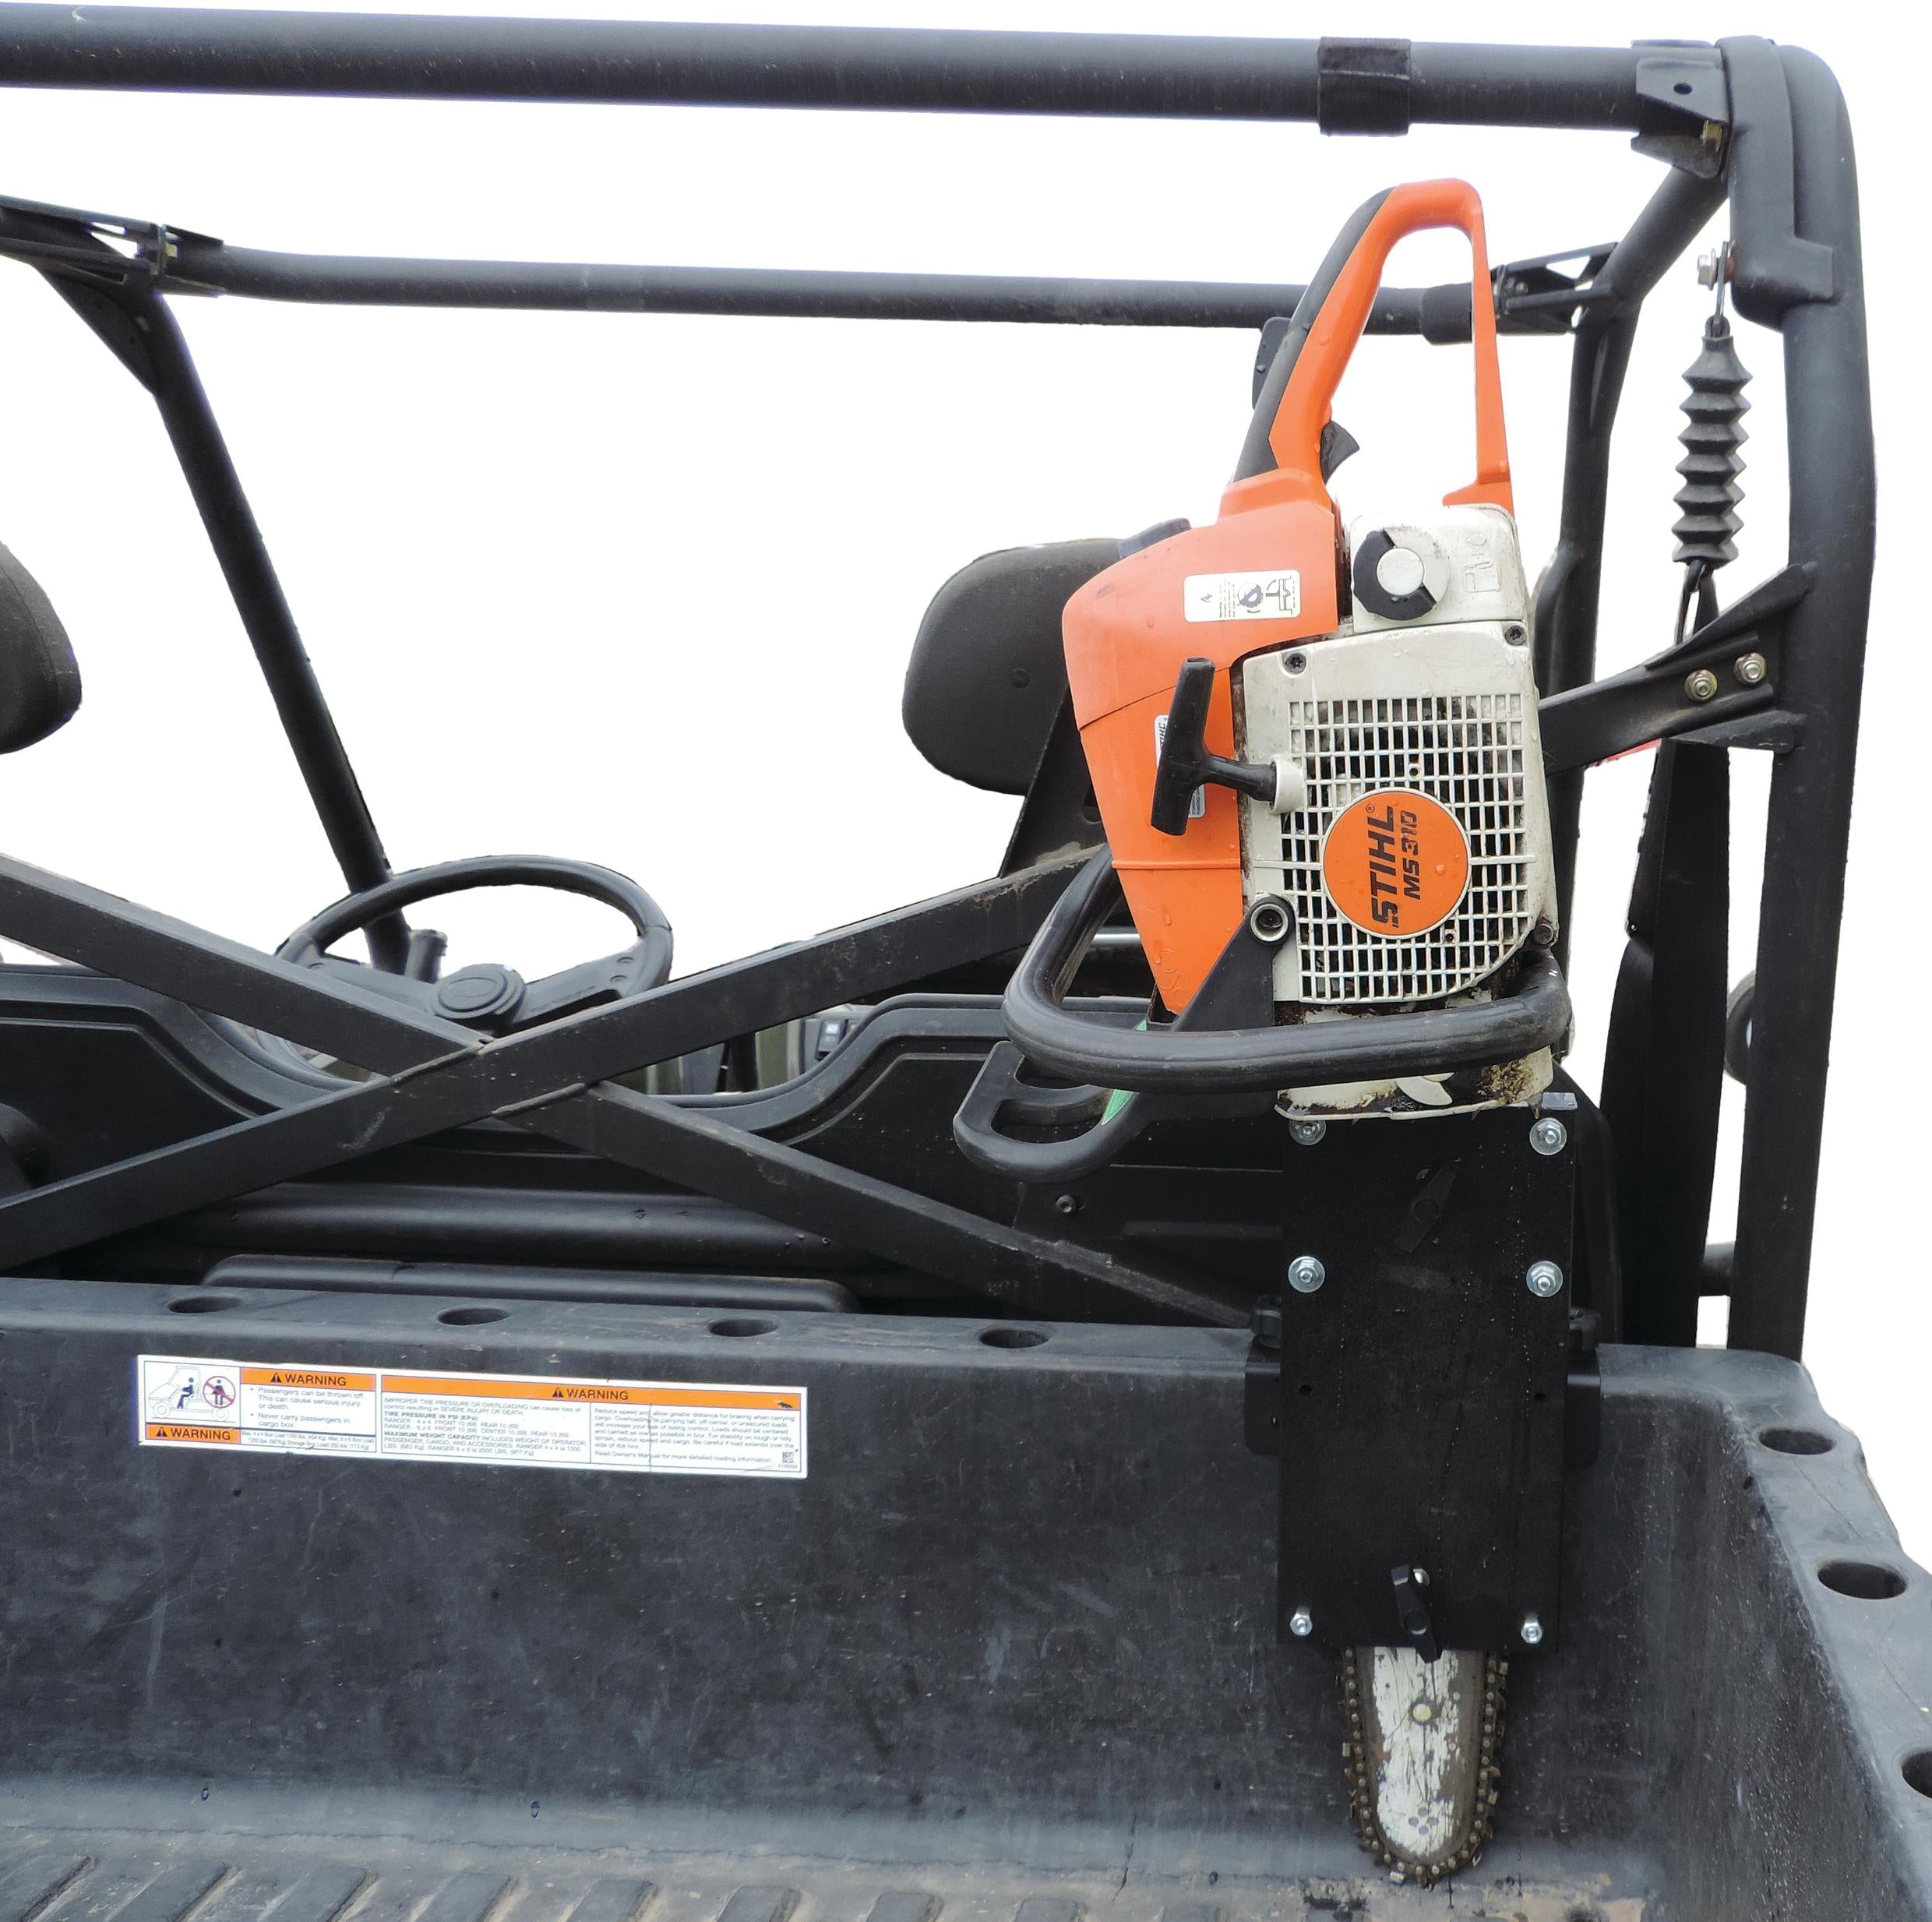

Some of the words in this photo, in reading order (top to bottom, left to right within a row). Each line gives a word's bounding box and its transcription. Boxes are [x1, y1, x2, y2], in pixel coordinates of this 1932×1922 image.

[1400, 809, 1419, 855] 310
[1367, 806, 1398, 928] STIHL
[1402, 857, 1421, 900] MS
[284, 1374, 347, 1386] WARNING
[258, 1387, 298, 1396] Passengers
[567, 1388, 628, 1401] WARNING
[171, 1427, 231, 1441] WARNING
